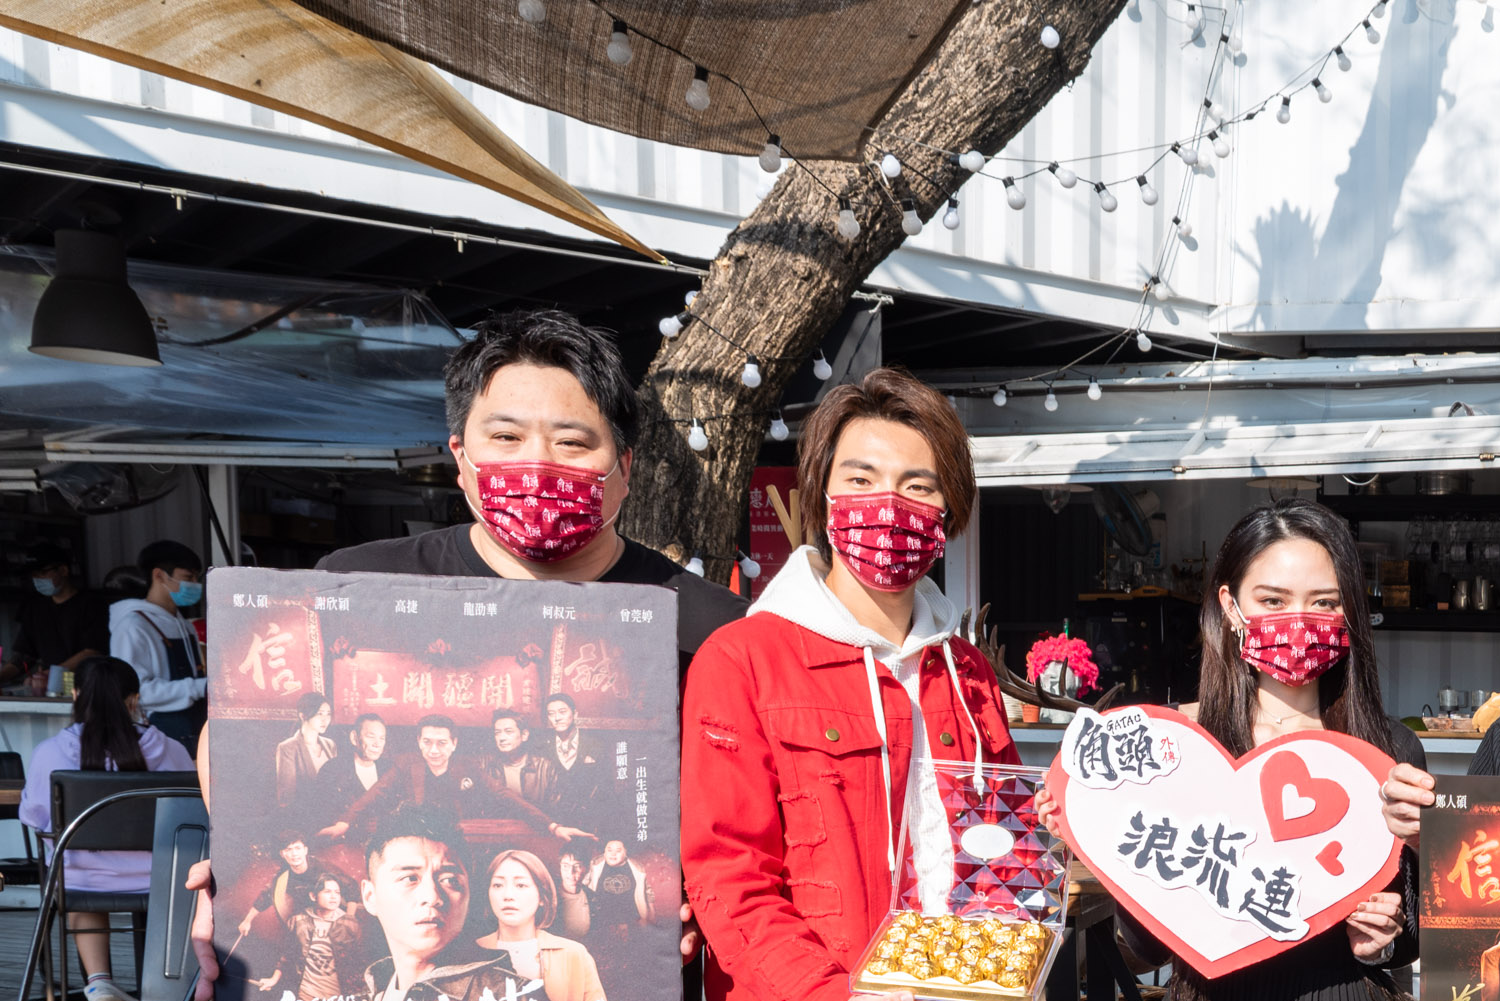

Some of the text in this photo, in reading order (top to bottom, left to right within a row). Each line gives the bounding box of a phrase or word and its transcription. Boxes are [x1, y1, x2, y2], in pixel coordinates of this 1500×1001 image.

[232, 594, 268, 609] 鄭人碩
[314, 596, 350, 611] 謝欣穎
[394, 599, 418, 614] 高捷
[463, 602, 498, 617] 龍劭華
[542, 605, 576, 620] 柯叔元
[620, 608, 653, 624] 曾莞婷
[238, 622, 301, 696] 信
[1106, 712, 1141, 734] GATAO
[1073, 717, 1161, 781] 角頭
[616, 741, 628, 780] 誰願意
[635, 756, 648, 842] 一出生就做兄弟
[1435, 794, 1467, 809] 鄭人碩
[1117, 810, 1297, 933] 浪流連
